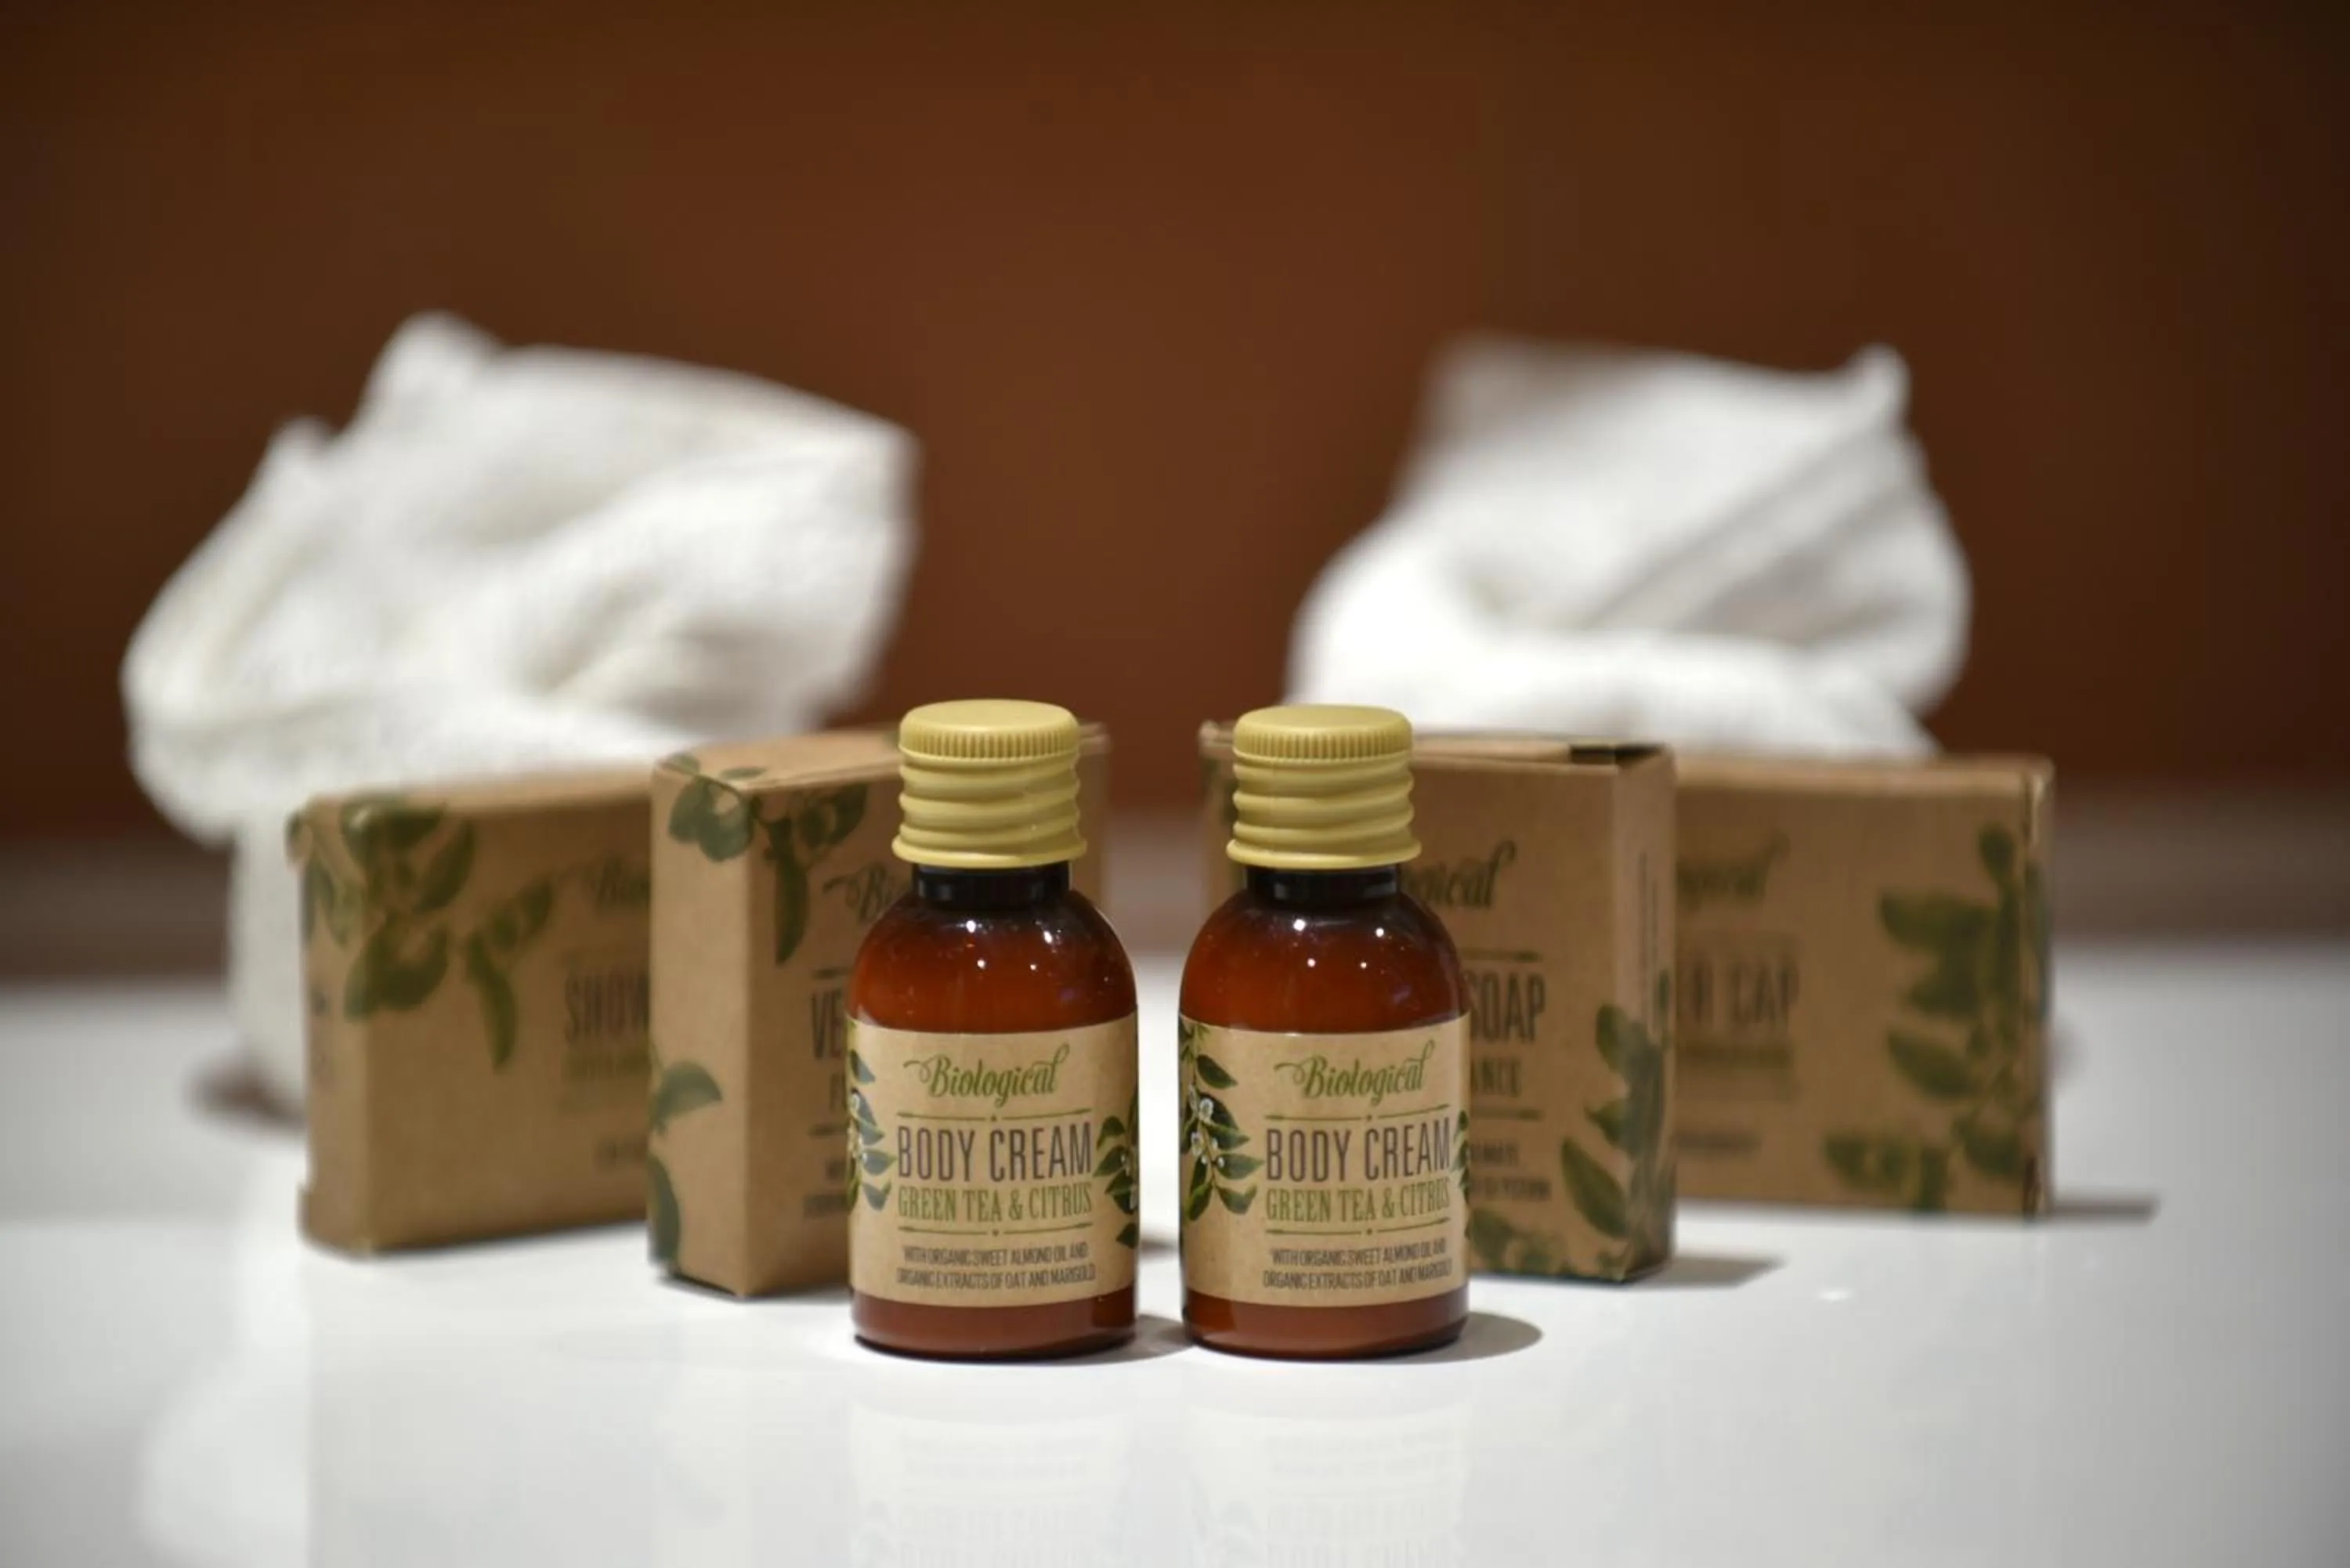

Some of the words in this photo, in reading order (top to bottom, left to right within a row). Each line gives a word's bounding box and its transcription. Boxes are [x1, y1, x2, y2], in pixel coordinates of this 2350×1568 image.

[903, 1043, 1070, 1108] Biological
[1274, 1039, 1435, 1106] Biological
[898, 1125, 975, 1182] BODY
[989, 1121, 1091, 1182] CREAM
[1266, 1128, 1351, 1182] BODY
[1365, 1116, 1450, 1181] CREAM
[898, 1183, 956, 1221] GREEN
[962, 1189, 1003, 1222] TEA
[1008, 1189, 1023, 1220] &
[1029, 1181, 1092, 1219] CITRUS
[1265, 1187, 1332, 1222] GREEN
[1337, 1187, 1377, 1222] TEA
[1382, 1186, 1397, 1219] &
[1399, 1176, 1451, 1217] CITRUS
[972, 1248, 1008, 1266] SWEET
[1271, 1248, 1298, 1266] WITH
[1347, 1247, 1380, 1266] SWEET
[1005, 1271, 1027, 1290] OAT
